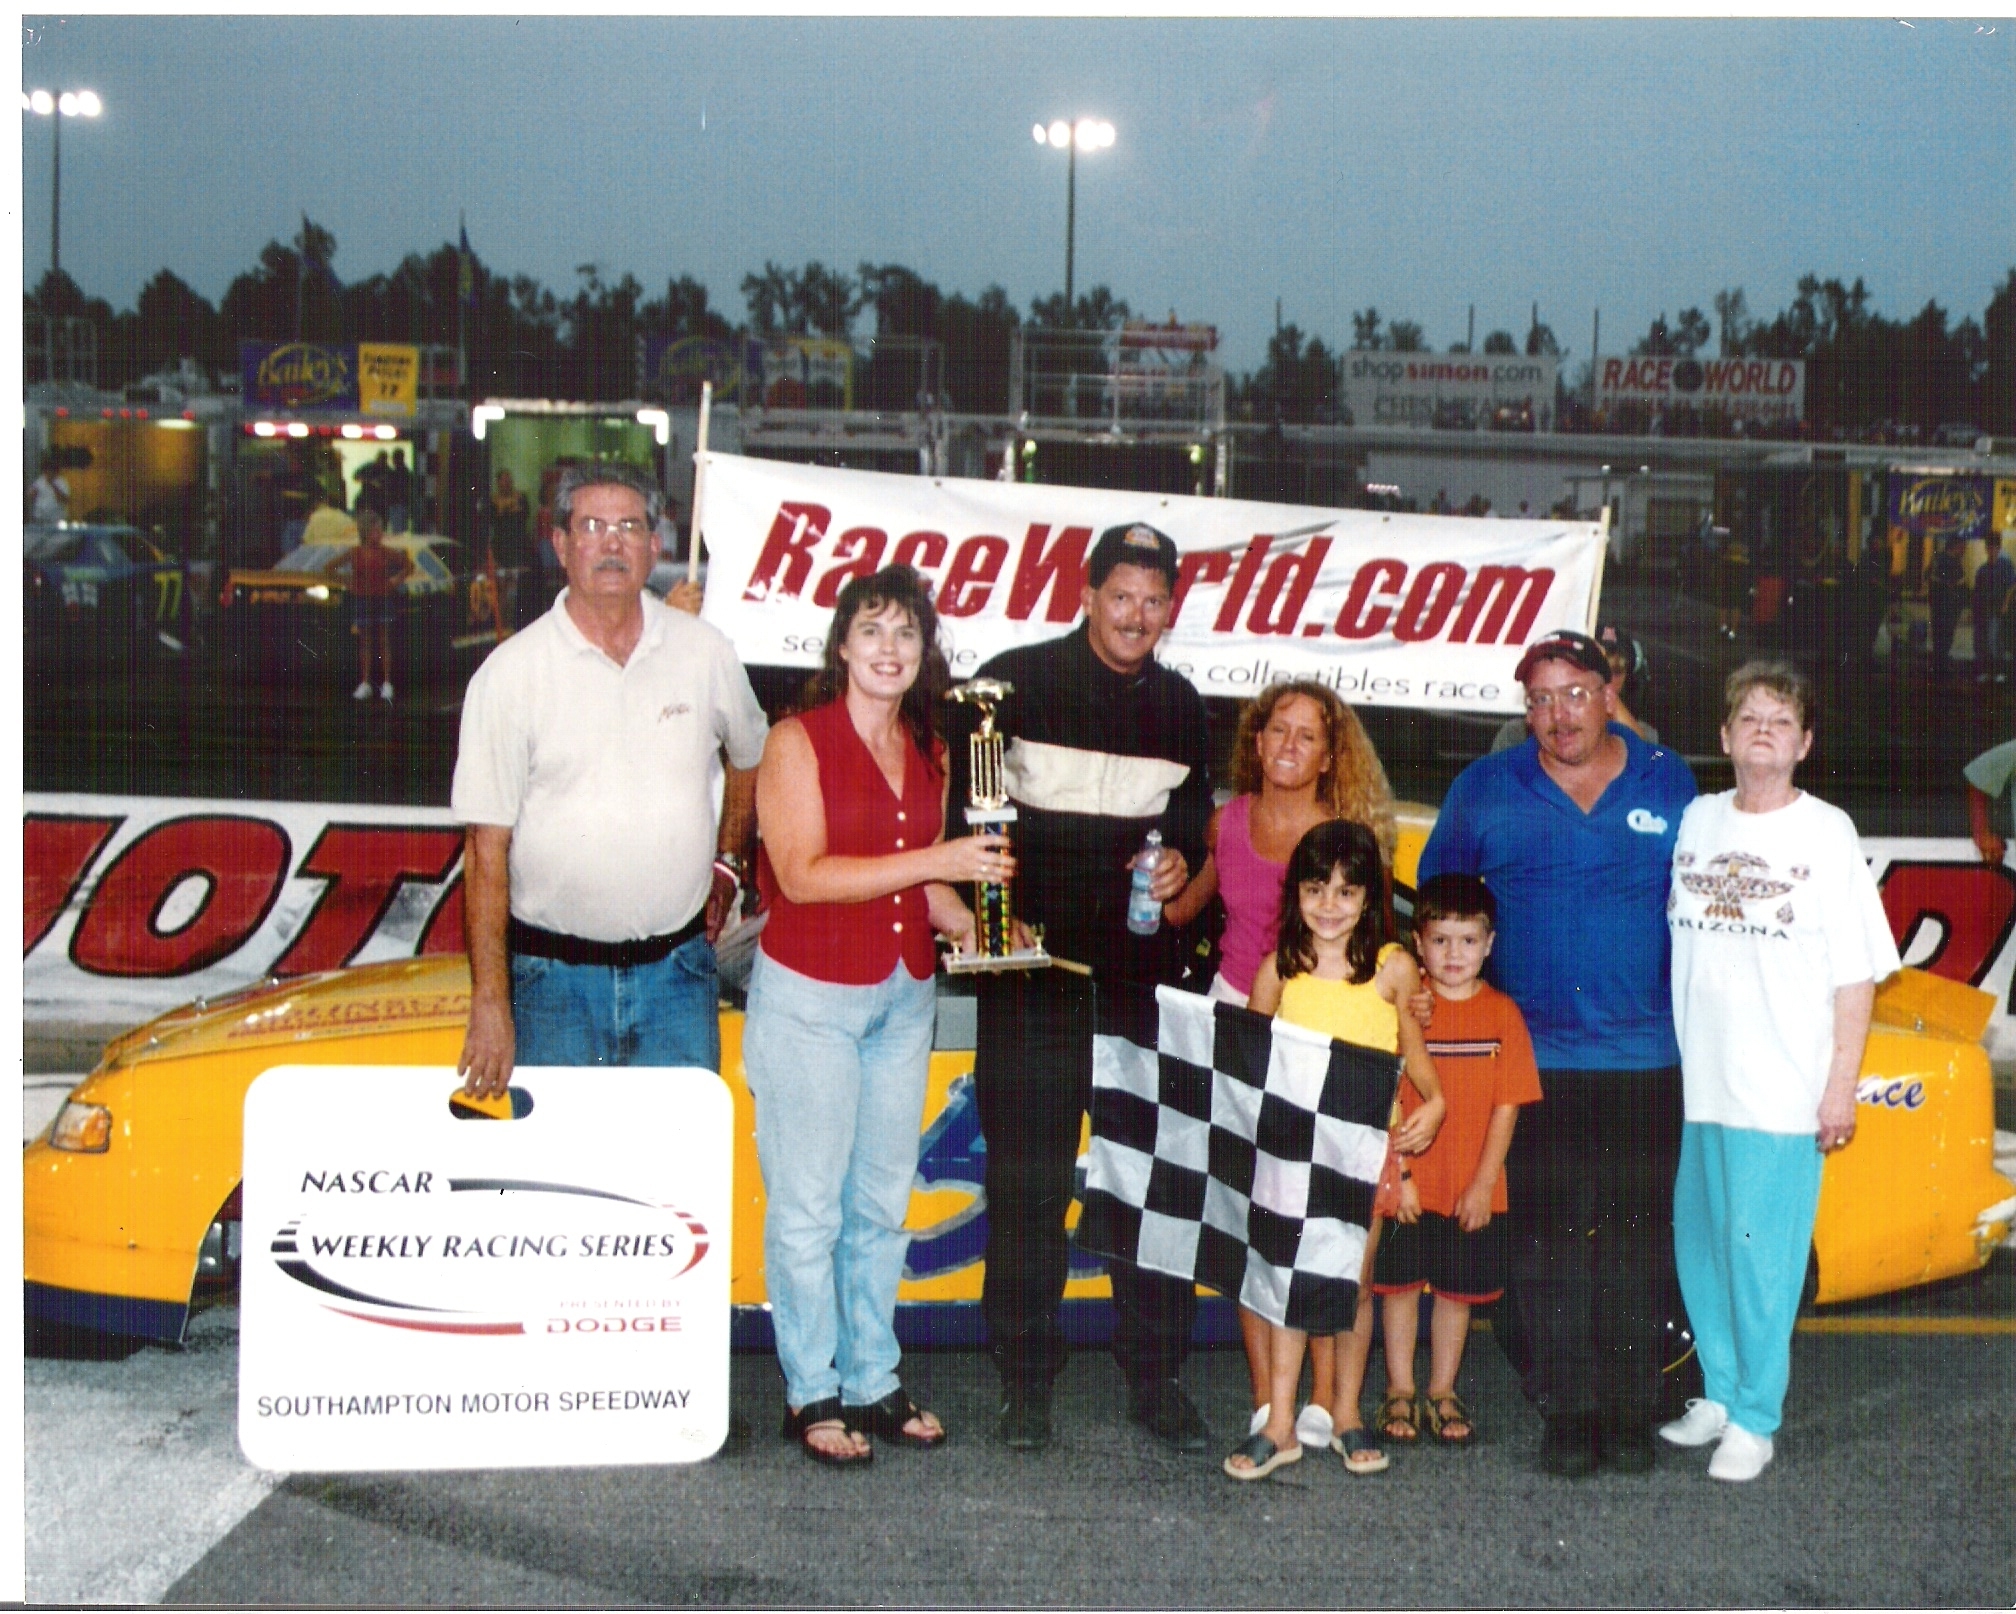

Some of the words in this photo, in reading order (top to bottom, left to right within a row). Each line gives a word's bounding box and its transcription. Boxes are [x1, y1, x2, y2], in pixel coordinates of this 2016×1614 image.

[1602, 358, 1673, 393] RACE
[1703, 360, 1797, 395] WORLD
[742, 500, 1555, 645] RaceWrld.com
[1207, 657, 1410, 694] collectibles
[1423, 675, 1501, 699] race
[301, 1170, 433, 1194] NASCAR
[312, 1235, 432, 1258] WEEKLY
[442, 1235, 567, 1258] RACING
[578, 1234, 675, 1257] SERIES
[661, 1299, 681, 1308] BY
[546, 1316, 683, 1333] DODGE
[257, 1395, 452, 1417] SOUTHAMPTON
[461, 1393, 550, 1413] MOTOR
[559, 1389, 691, 1411] SPEEDWAY
